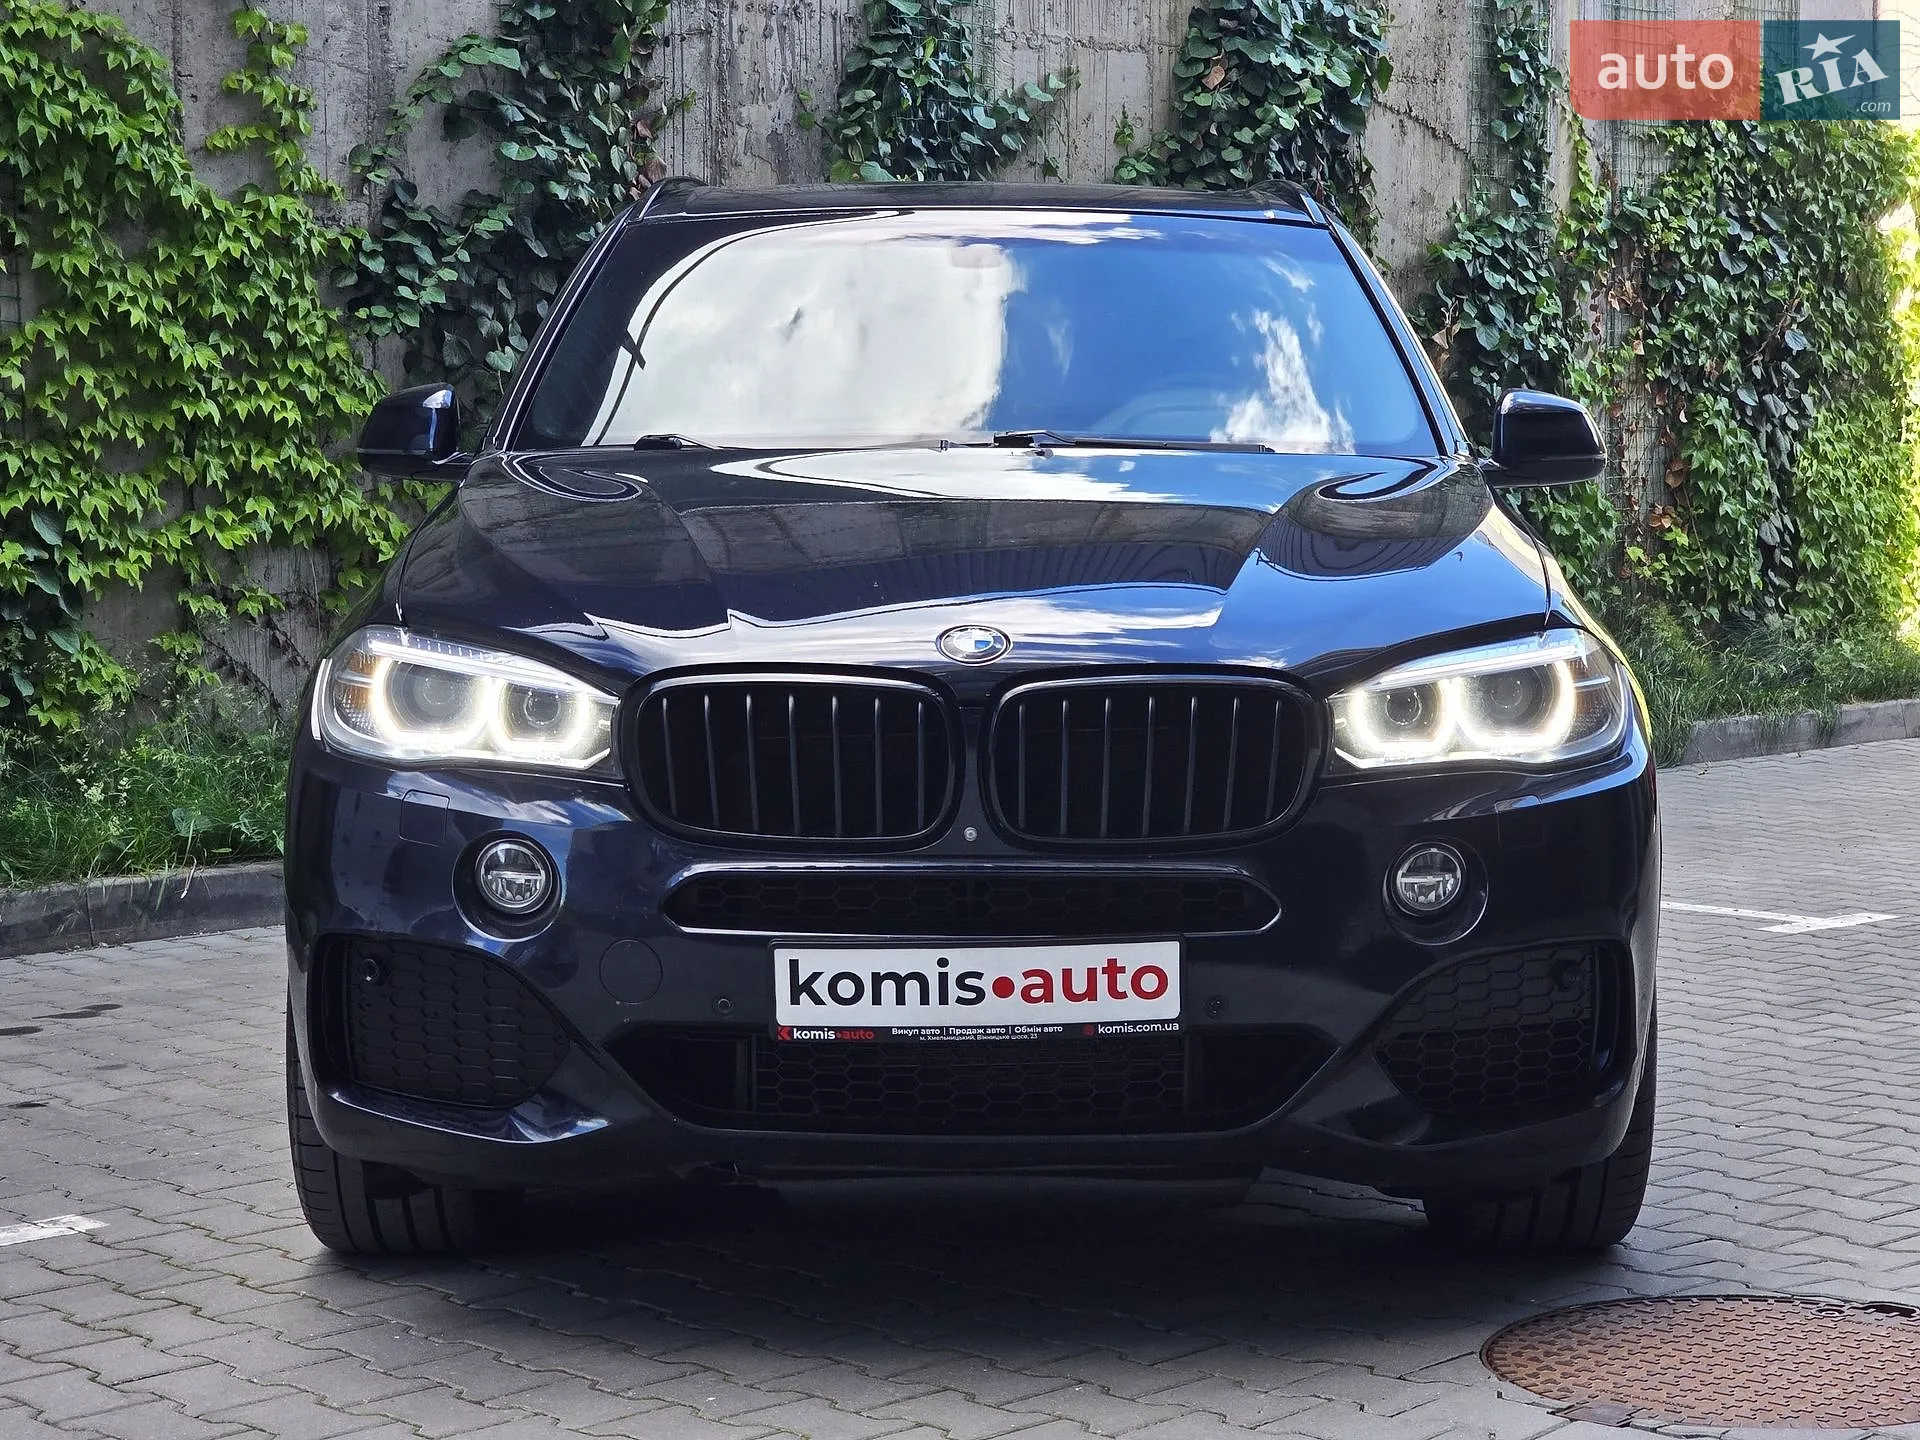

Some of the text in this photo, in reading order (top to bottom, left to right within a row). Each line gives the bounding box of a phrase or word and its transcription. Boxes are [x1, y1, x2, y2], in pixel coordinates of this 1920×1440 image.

[891, 1027, 919, 1036] Викуп
[949, 1027, 984, 1036] Продаж
[1014, 1025, 1041, 1034] Обмін
[1098, 1023, 1180, 1035] komis.com.ua
